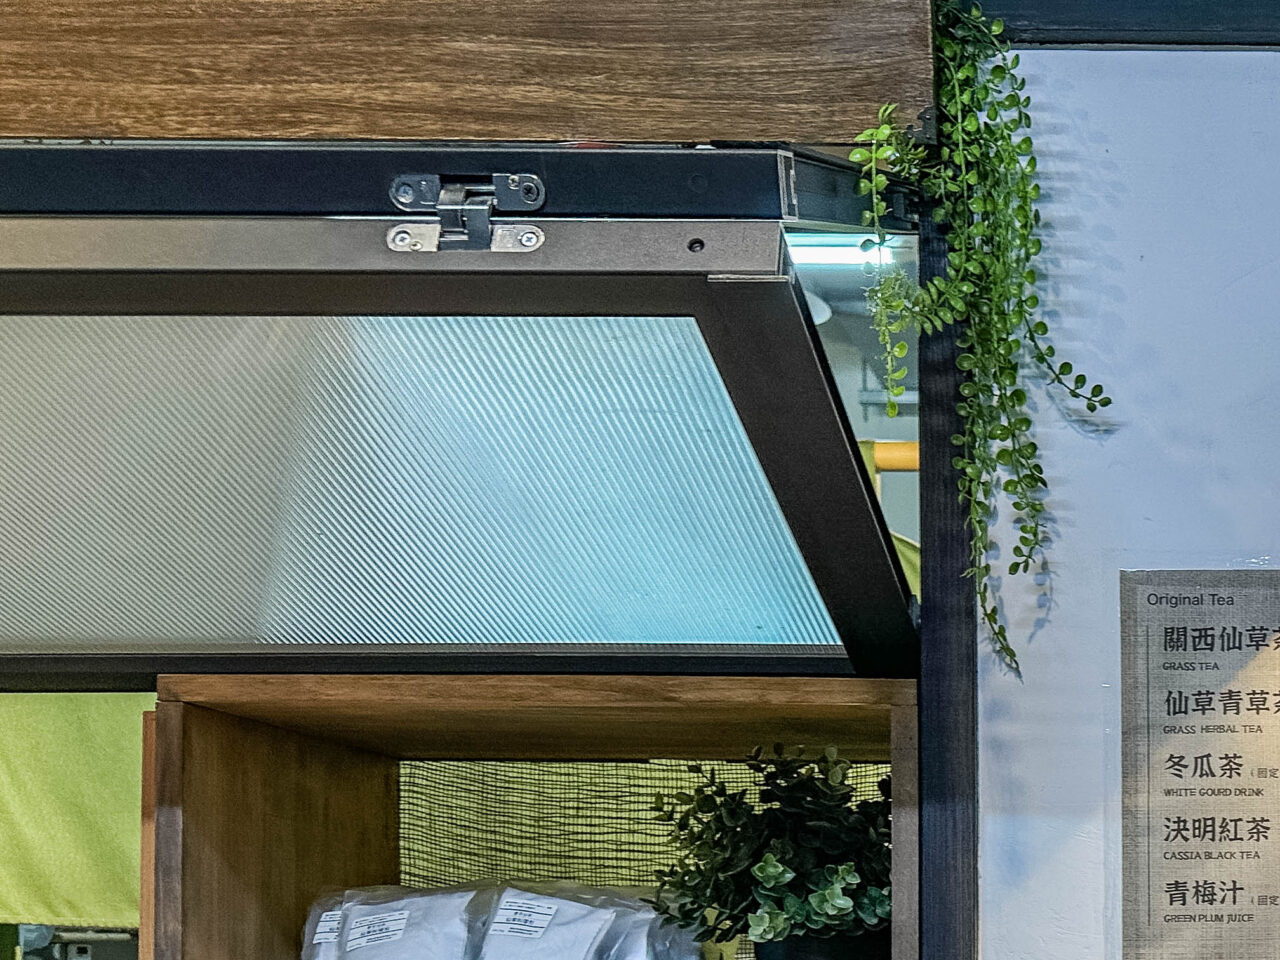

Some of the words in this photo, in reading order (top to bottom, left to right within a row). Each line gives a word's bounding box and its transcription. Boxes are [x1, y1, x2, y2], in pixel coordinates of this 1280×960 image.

[1147, 593, 1203, 608] Original
[1209, 594, 1234, 606] Tea
[1162, 662, 1196, 671] GRASS
[1198, 662, 1219, 671] TEA
[1163, 725, 1196, 734] GRASS
[1201, 725, 1238, 734] HERBAL
[1242, 725, 1263, 733] TEA
[1165, 753, 1243, 779] 冬瓜茶
[1164, 788, 1196, 797] WHITE
[1199, 788, 1232, 797] GOURD
[1234, 788, 1264, 797] DRINK
[1163, 816, 1271, 842] 決明紅茶
[1164, 851, 1202, 860] CASSIA
[1204, 851, 1236, 860] BLACK
[1239, 851, 1260, 860] TEA
[1165, 880, 1244, 906] 青梅汁
[1164, 914, 1197, 923] GREEN
[1198, 914, 1224, 922] PLUM
[1227, 914, 1254, 922] JUICE
